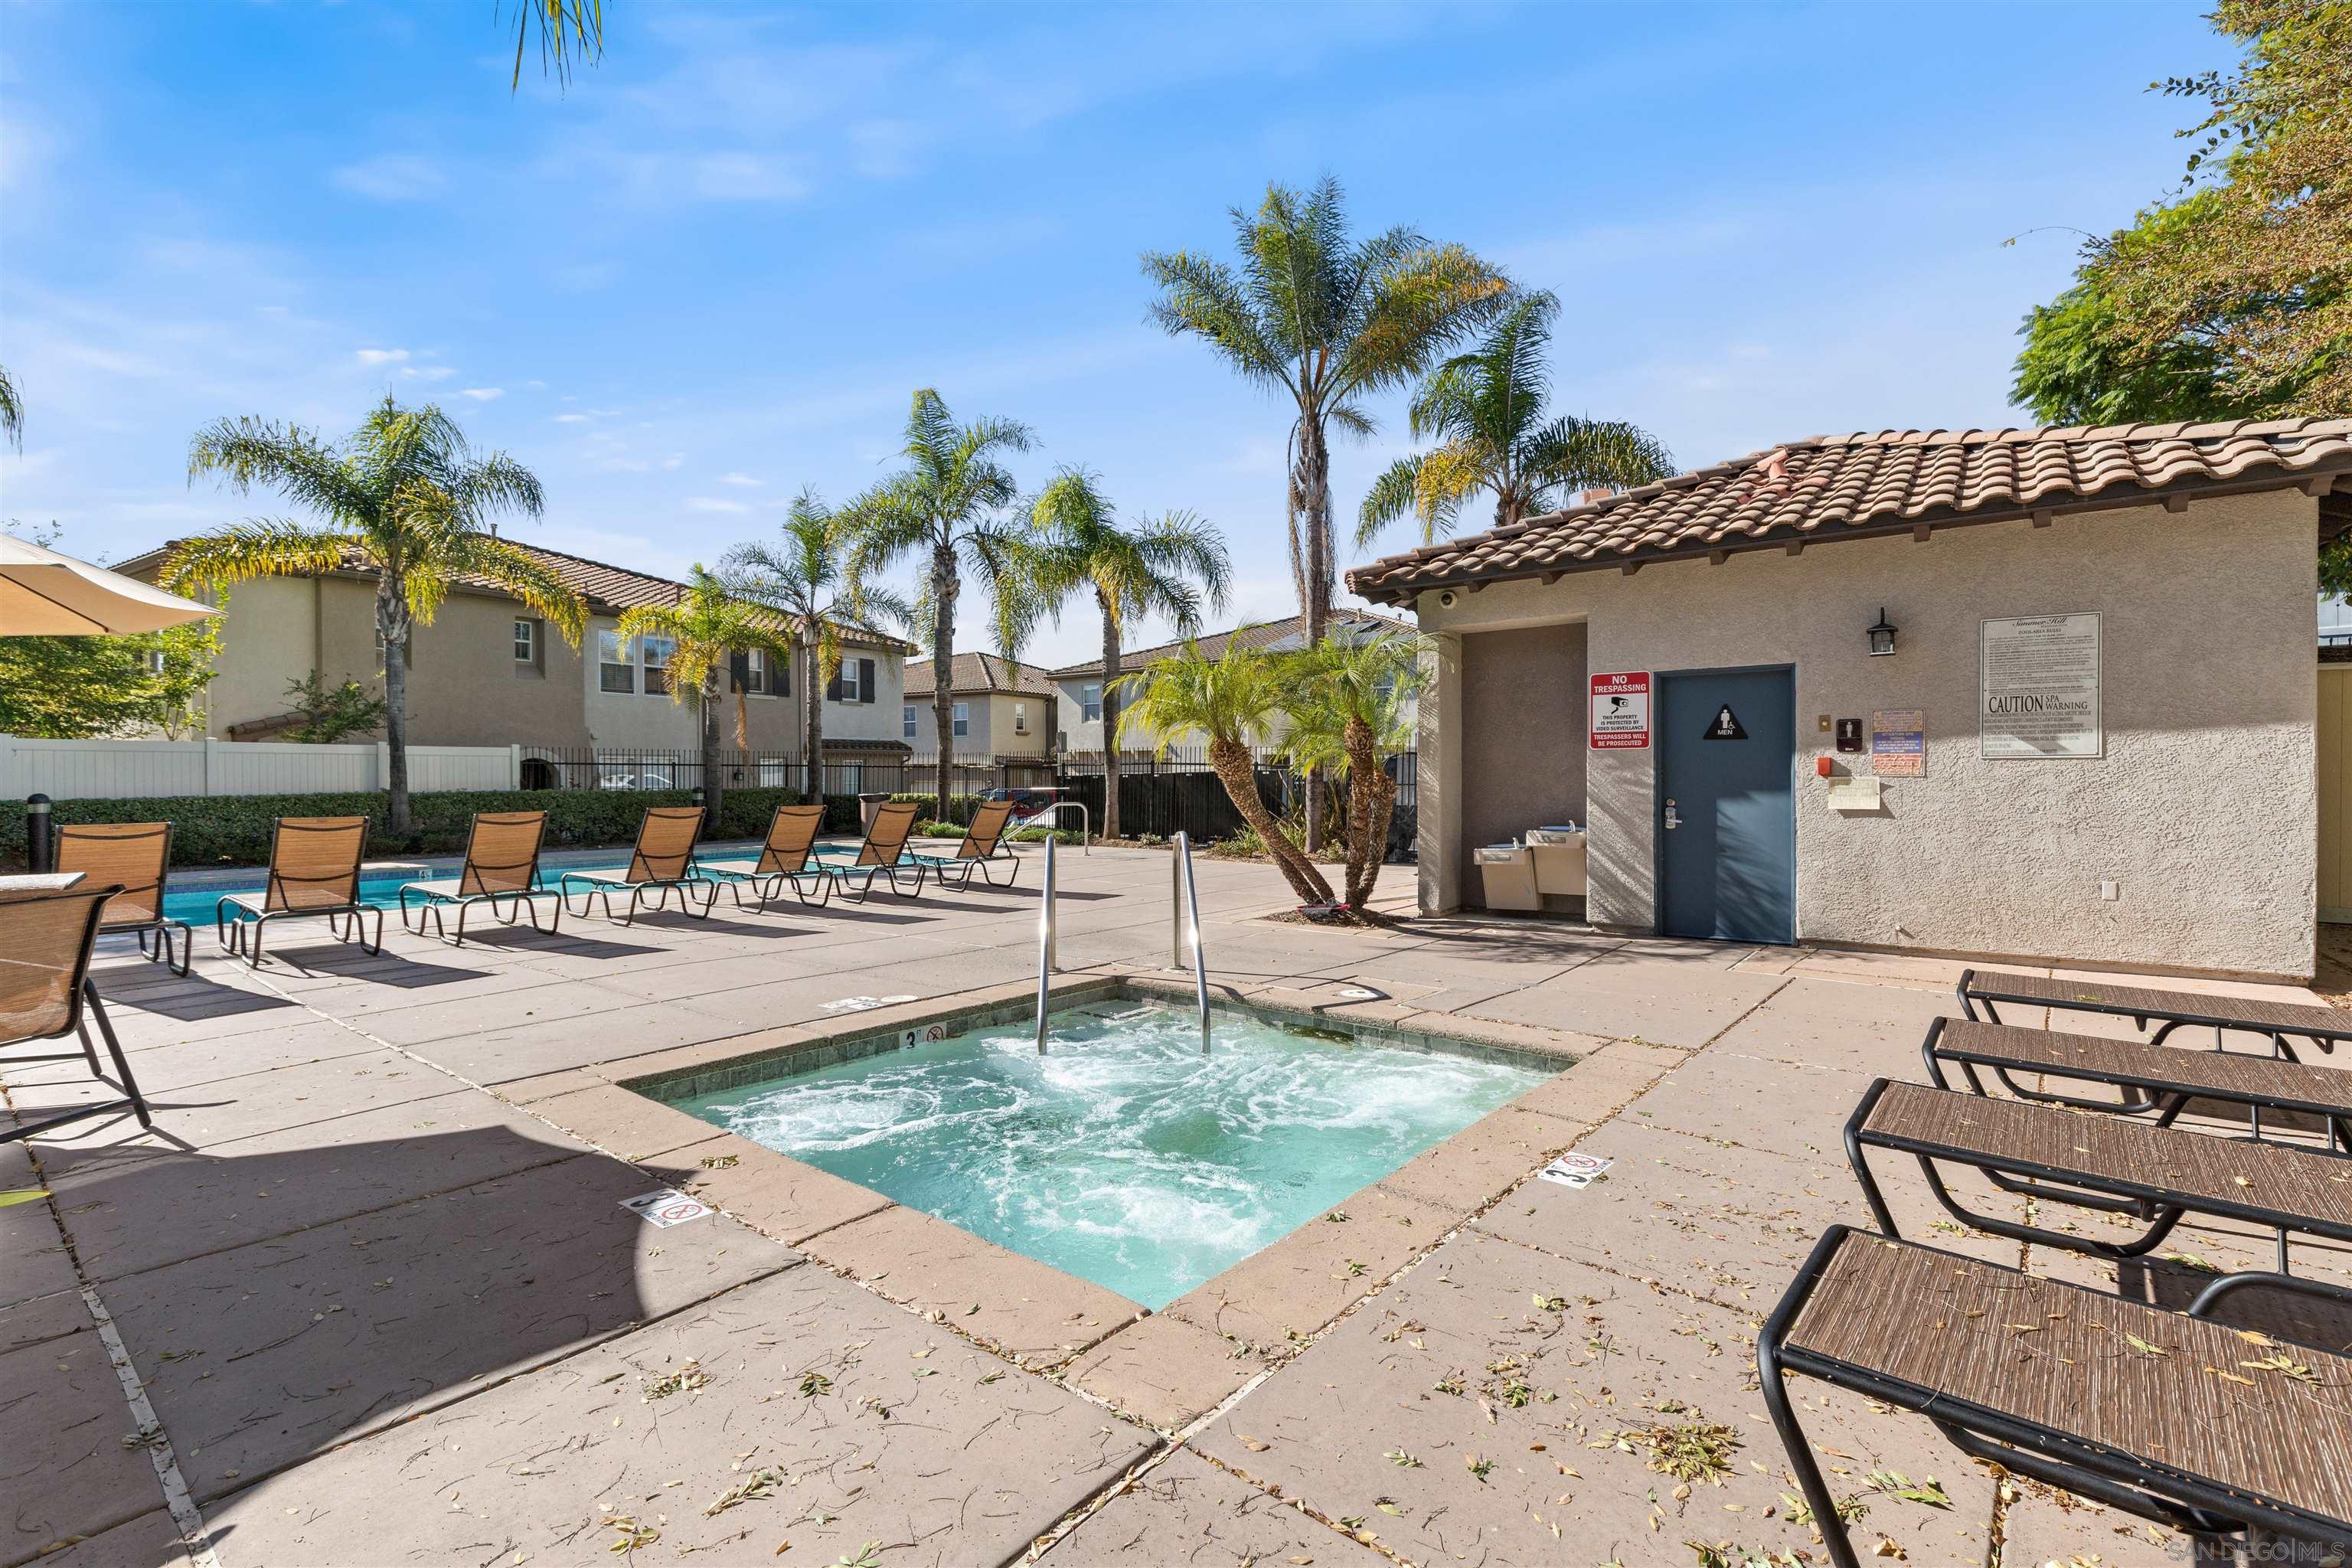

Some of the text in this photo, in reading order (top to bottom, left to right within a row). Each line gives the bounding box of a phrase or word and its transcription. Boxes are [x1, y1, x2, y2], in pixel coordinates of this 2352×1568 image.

[1612, 675, 1628, 684] NO
[1594, 684, 1646, 693] TRESPASSING
[1988, 694, 2043, 713] CAUTION
[2046, 701, 2088, 710] WARNING
[1546, 1169, 1588, 1183] 3
